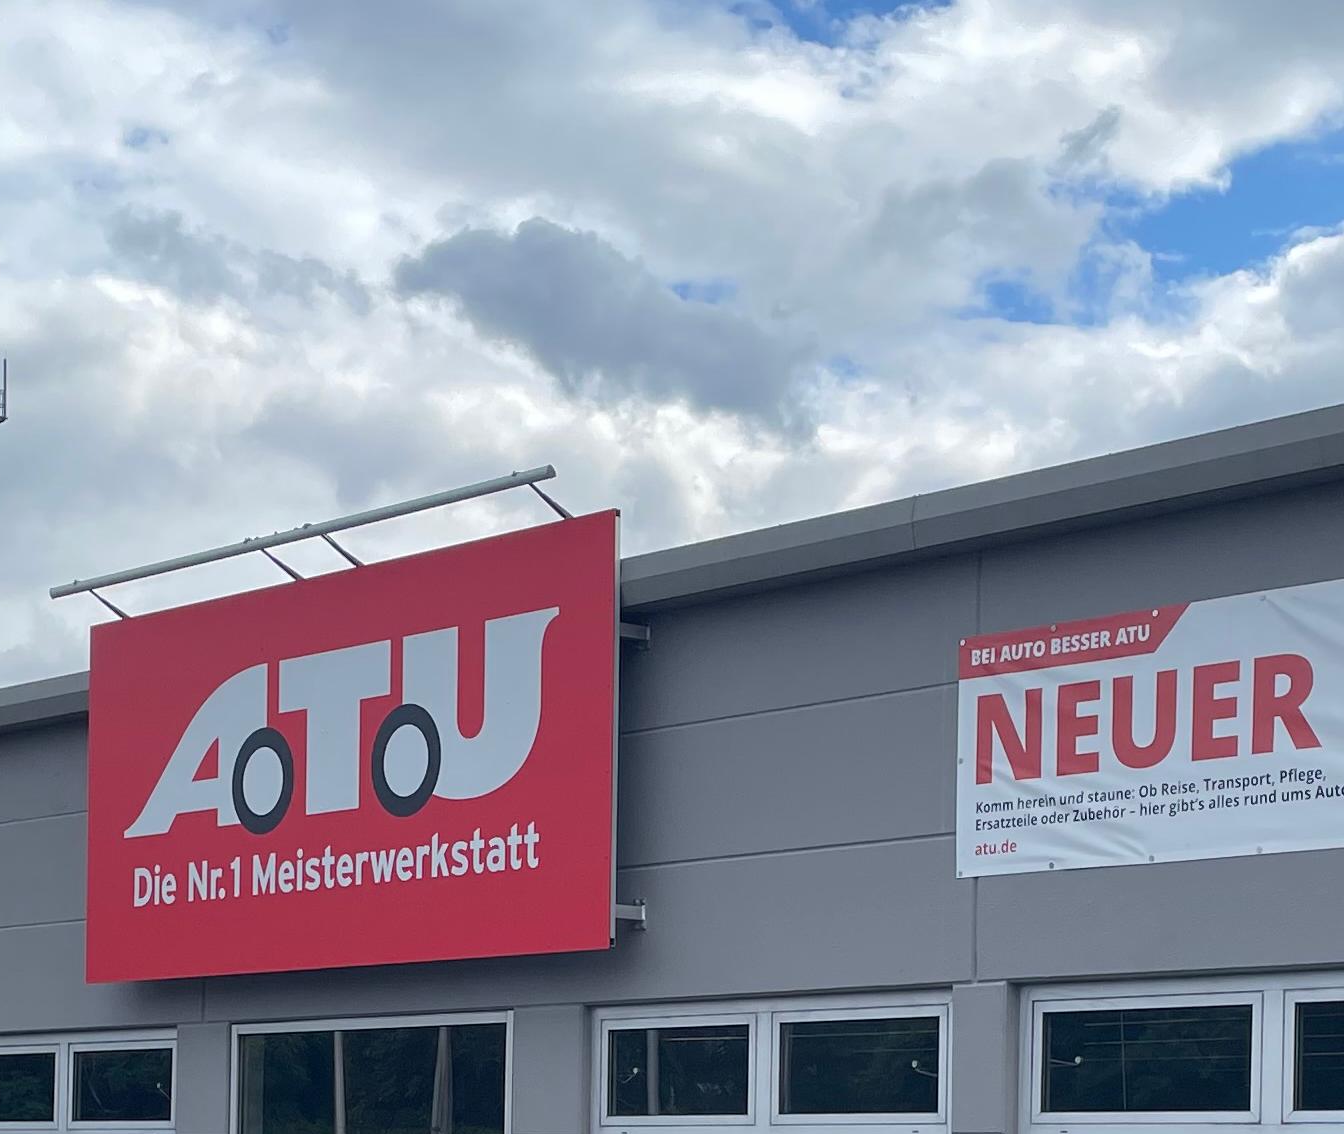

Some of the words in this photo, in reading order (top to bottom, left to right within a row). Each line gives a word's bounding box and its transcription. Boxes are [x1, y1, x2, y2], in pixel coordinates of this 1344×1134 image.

[972, 648, 996, 666] BEI
[1000, 640, 1045, 663] AUTO
[1051, 631, 1111, 655] BESSER
[1115, 624, 1150, 645] ATU
[124, 607, 559, 838] ATU
[975, 653, 1322, 785] NEUER
[975, 813, 1038, 831] Ersatzteile
[1041, 810, 1068, 825] oder
[1073, 805, 1126, 822] Zubehör
[1140, 801, 1164, 817] hier
[1208, 793, 1240, 809] alles
[1244, 790, 1276, 806] rund
[1281, 789, 1311, 802] ums
[976, 799, 1014, 814] Komm
[1017, 794, 1056, 811] herein
[1059, 791, 1084, 806] und
[1087, 787, 1135, 804] staune:
[1139, 784, 1157, 798] Ob
[1161, 780, 1199, 797] Reise,
[1203, 773, 1275, 794] Transport,
[1279, 768, 1326, 787] Pflege,
[134, 865, 176, 907] Die
[252, 821, 539, 896] Meisterwerkstatt
[975, 840, 1017, 856] atu.de
